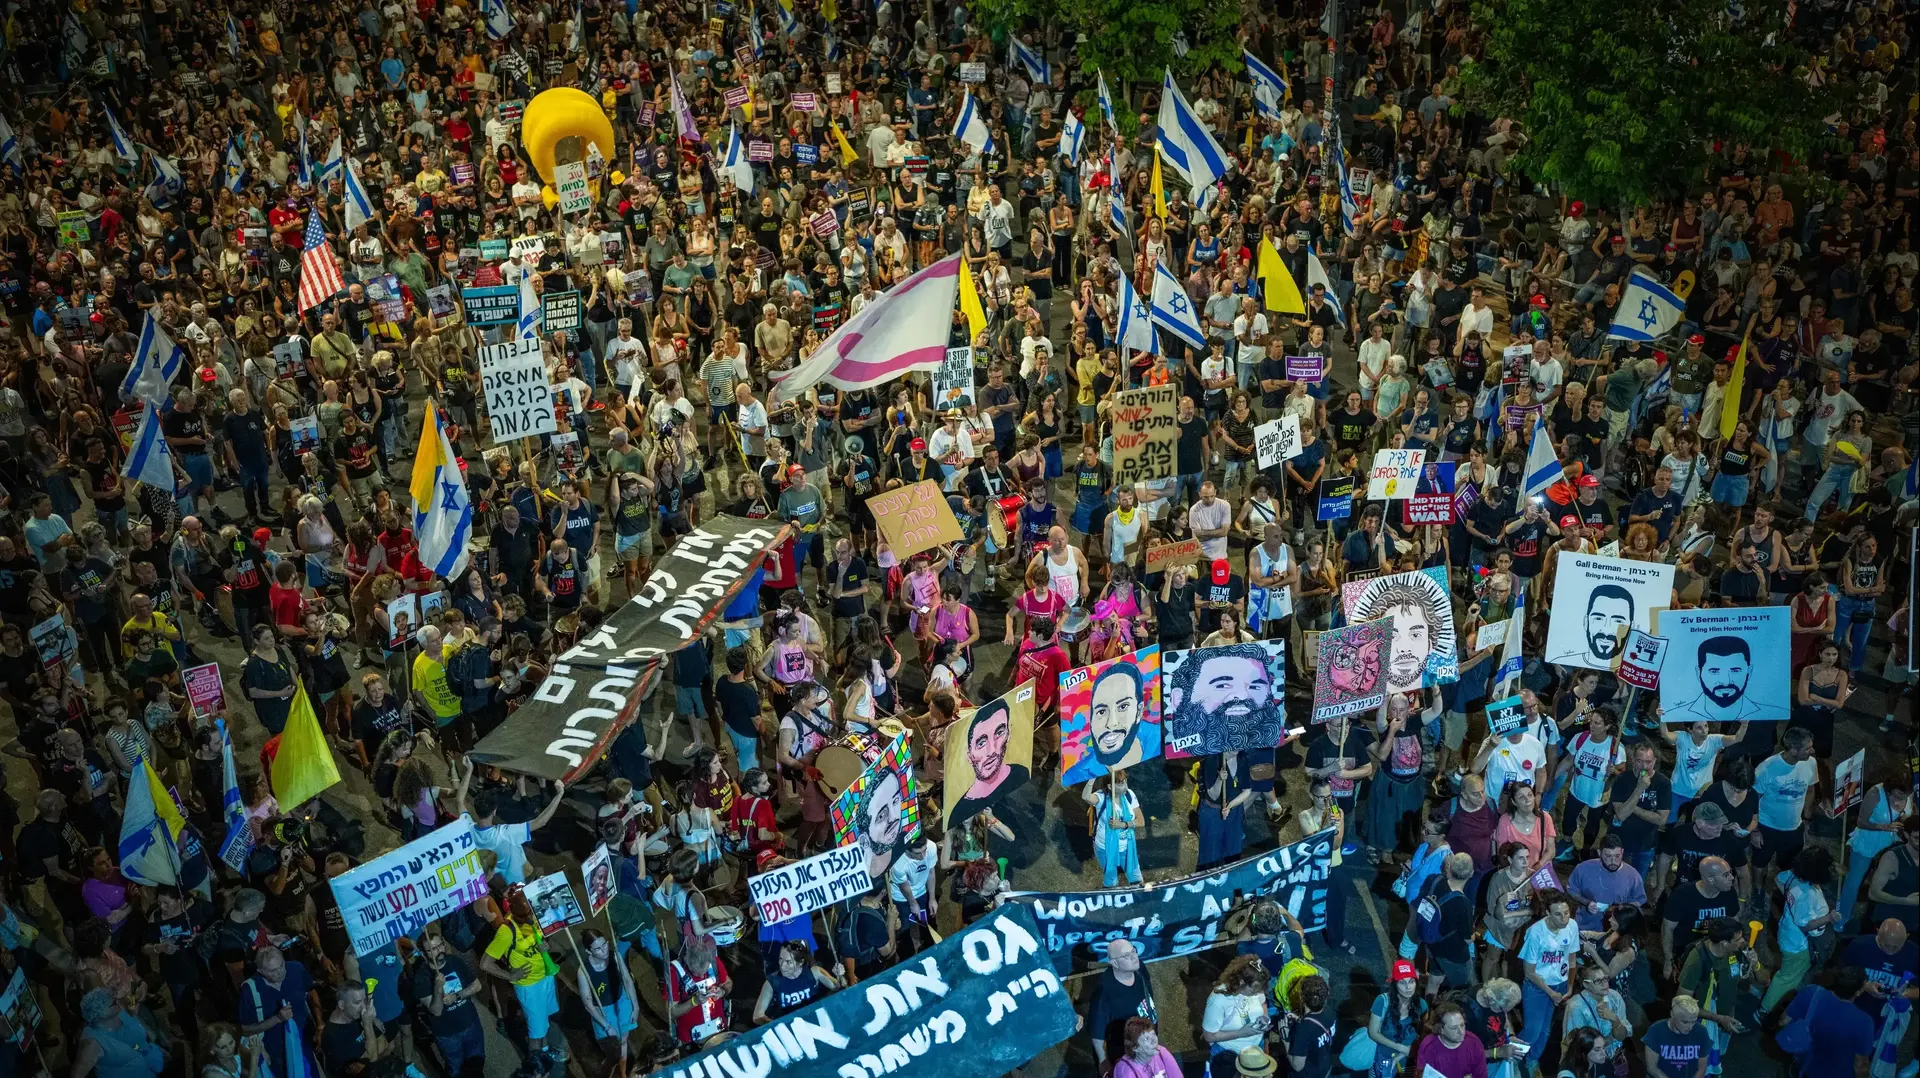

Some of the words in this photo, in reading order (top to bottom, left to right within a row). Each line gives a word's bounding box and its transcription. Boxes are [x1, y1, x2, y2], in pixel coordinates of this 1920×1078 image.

[499, 295, 517, 306] כמה
[546, 306, 578, 318] המלחמה
[953, 349, 969, 360] STOP
[950, 359, 967, 370] WAR!
[483, 366, 542, 390] ממשלה
[955, 368, 972, 379] THEM
[949, 378, 970, 390] HOME!
[492, 385, 547, 409] בוגדת
[1120, 389, 1173, 406] הורגים:
[490, 408, 550, 437] בעמה
[1129, 415, 1173, 431] מתים:
[1343, 425, 1362, 433] SEAL
[1139, 439, 1172, 456] את
[1123, 453, 1171, 470] כולם
[899, 503, 938, 525] עסקה
[1409, 511, 1450, 523] WAR
[903, 522, 942, 548] אחת
[672, 527, 723, 565] אין
[1147, 549, 1176, 563] DEAD
[1575, 560, 1591, 569] Gali
[1592, 562, 1622, 573] Berman
[1629, 568, 1647, 576] ברמן
[1648, 569, 1660, 577] גלי
[1585, 572, 1601, 580] Bring
[1614, 575, 1631, 583] Home
[1222, 587, 1230, 595] MY
[1696, 615, 1729, 623] Berman
[1737, 615, 1758, 624] ברמן
[1065, 671, 1087, 690] מתן
[1438, 667, 1454, 677] אלון
[191, 681, 219, 695] עסקה
[1317, 703, 1347, 718] אחת!
[1350, 695, 1382, 710] פעימה
[1500, 706, 1514, 718] לא
[1174, 737, 1198, 751] איתן
[454, 831, 473, 850] מי
[407, 841, 454, 875] האיש
[436, 848, 482, 890] חיים
[794, 863, 817, 890] את
[352, 864, 408, 900] החפץ
[416, 875, 438, 899] סור
[751, 871, 793, 899] העולם
[828, 869, 870, 900] החיילים
[448, 873, 490, 912] טוב
[795, 886, 828, 912] מתים
[757, 896, 792, 924] סתם!
[385, 907, 428, 941] שלום
[862, 956, 949, 1036] את
[985, 968, 1060, 1026] היית
